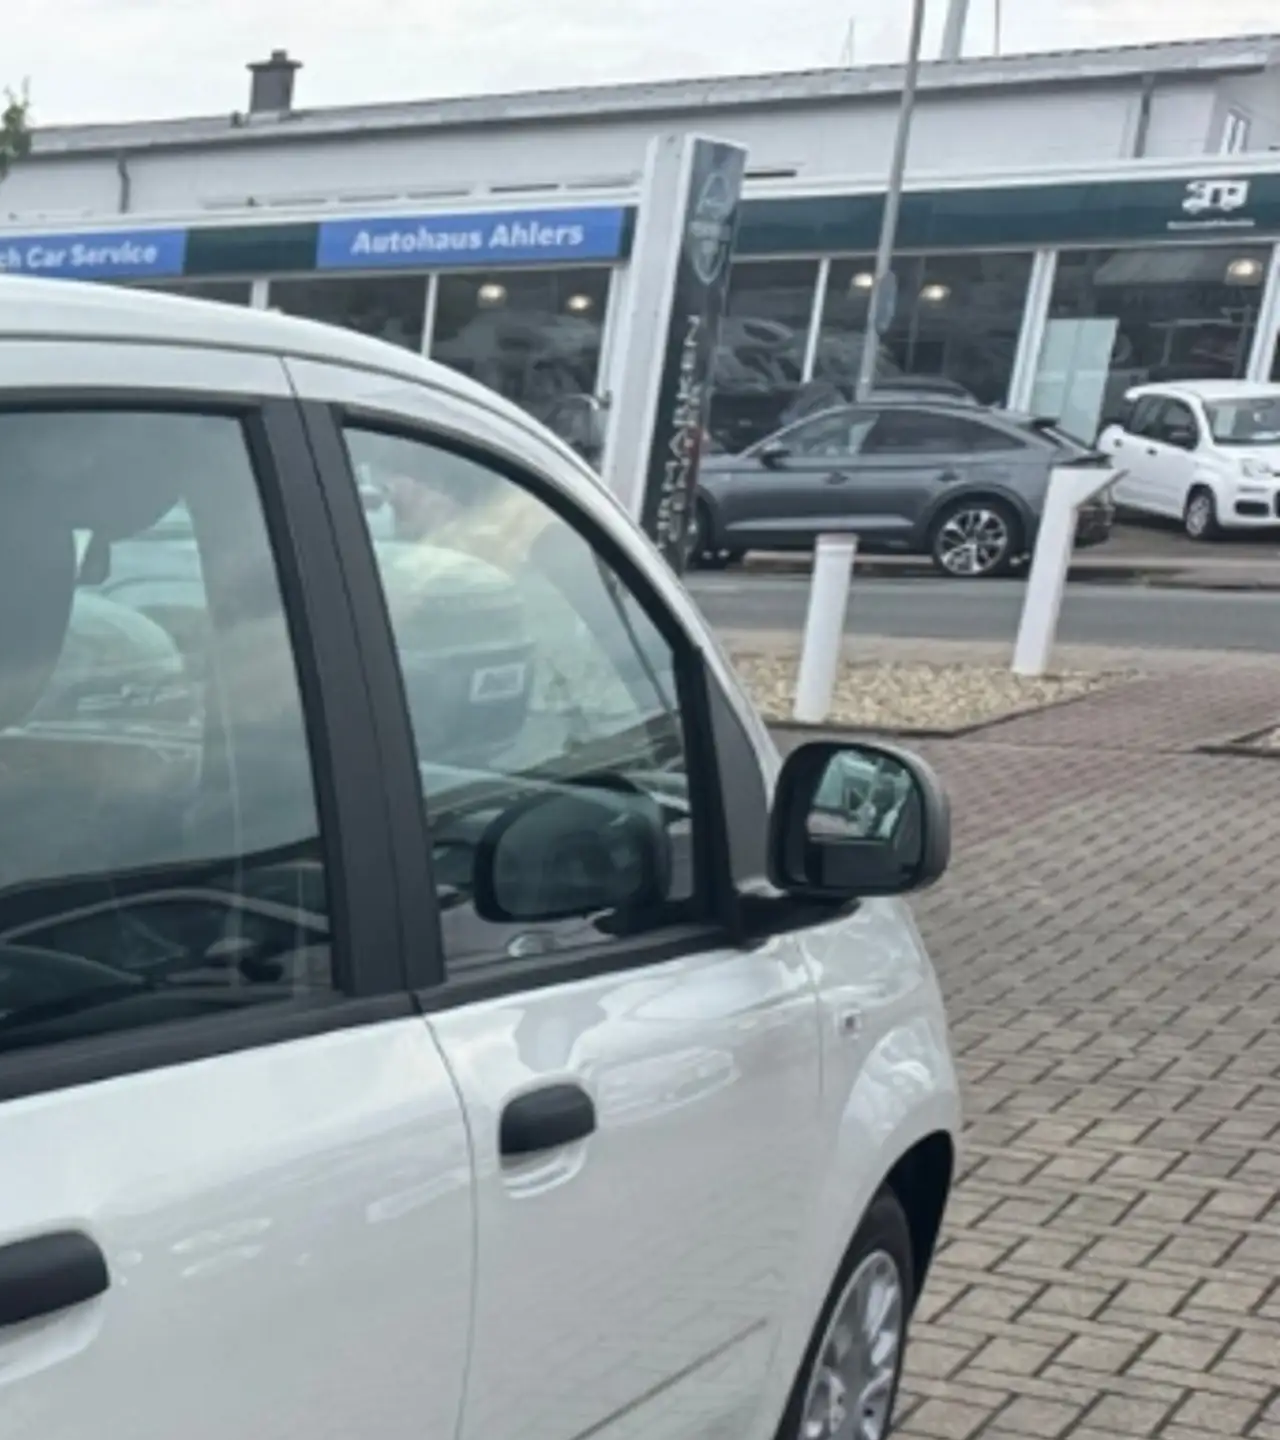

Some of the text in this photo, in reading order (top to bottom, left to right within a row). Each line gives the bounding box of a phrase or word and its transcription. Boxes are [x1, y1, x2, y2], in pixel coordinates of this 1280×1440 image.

[350, 221, 584, 255] Autohaus Ahlers
[26, 244, 67, 268] Car
[71, 240, 158, 267] Service
